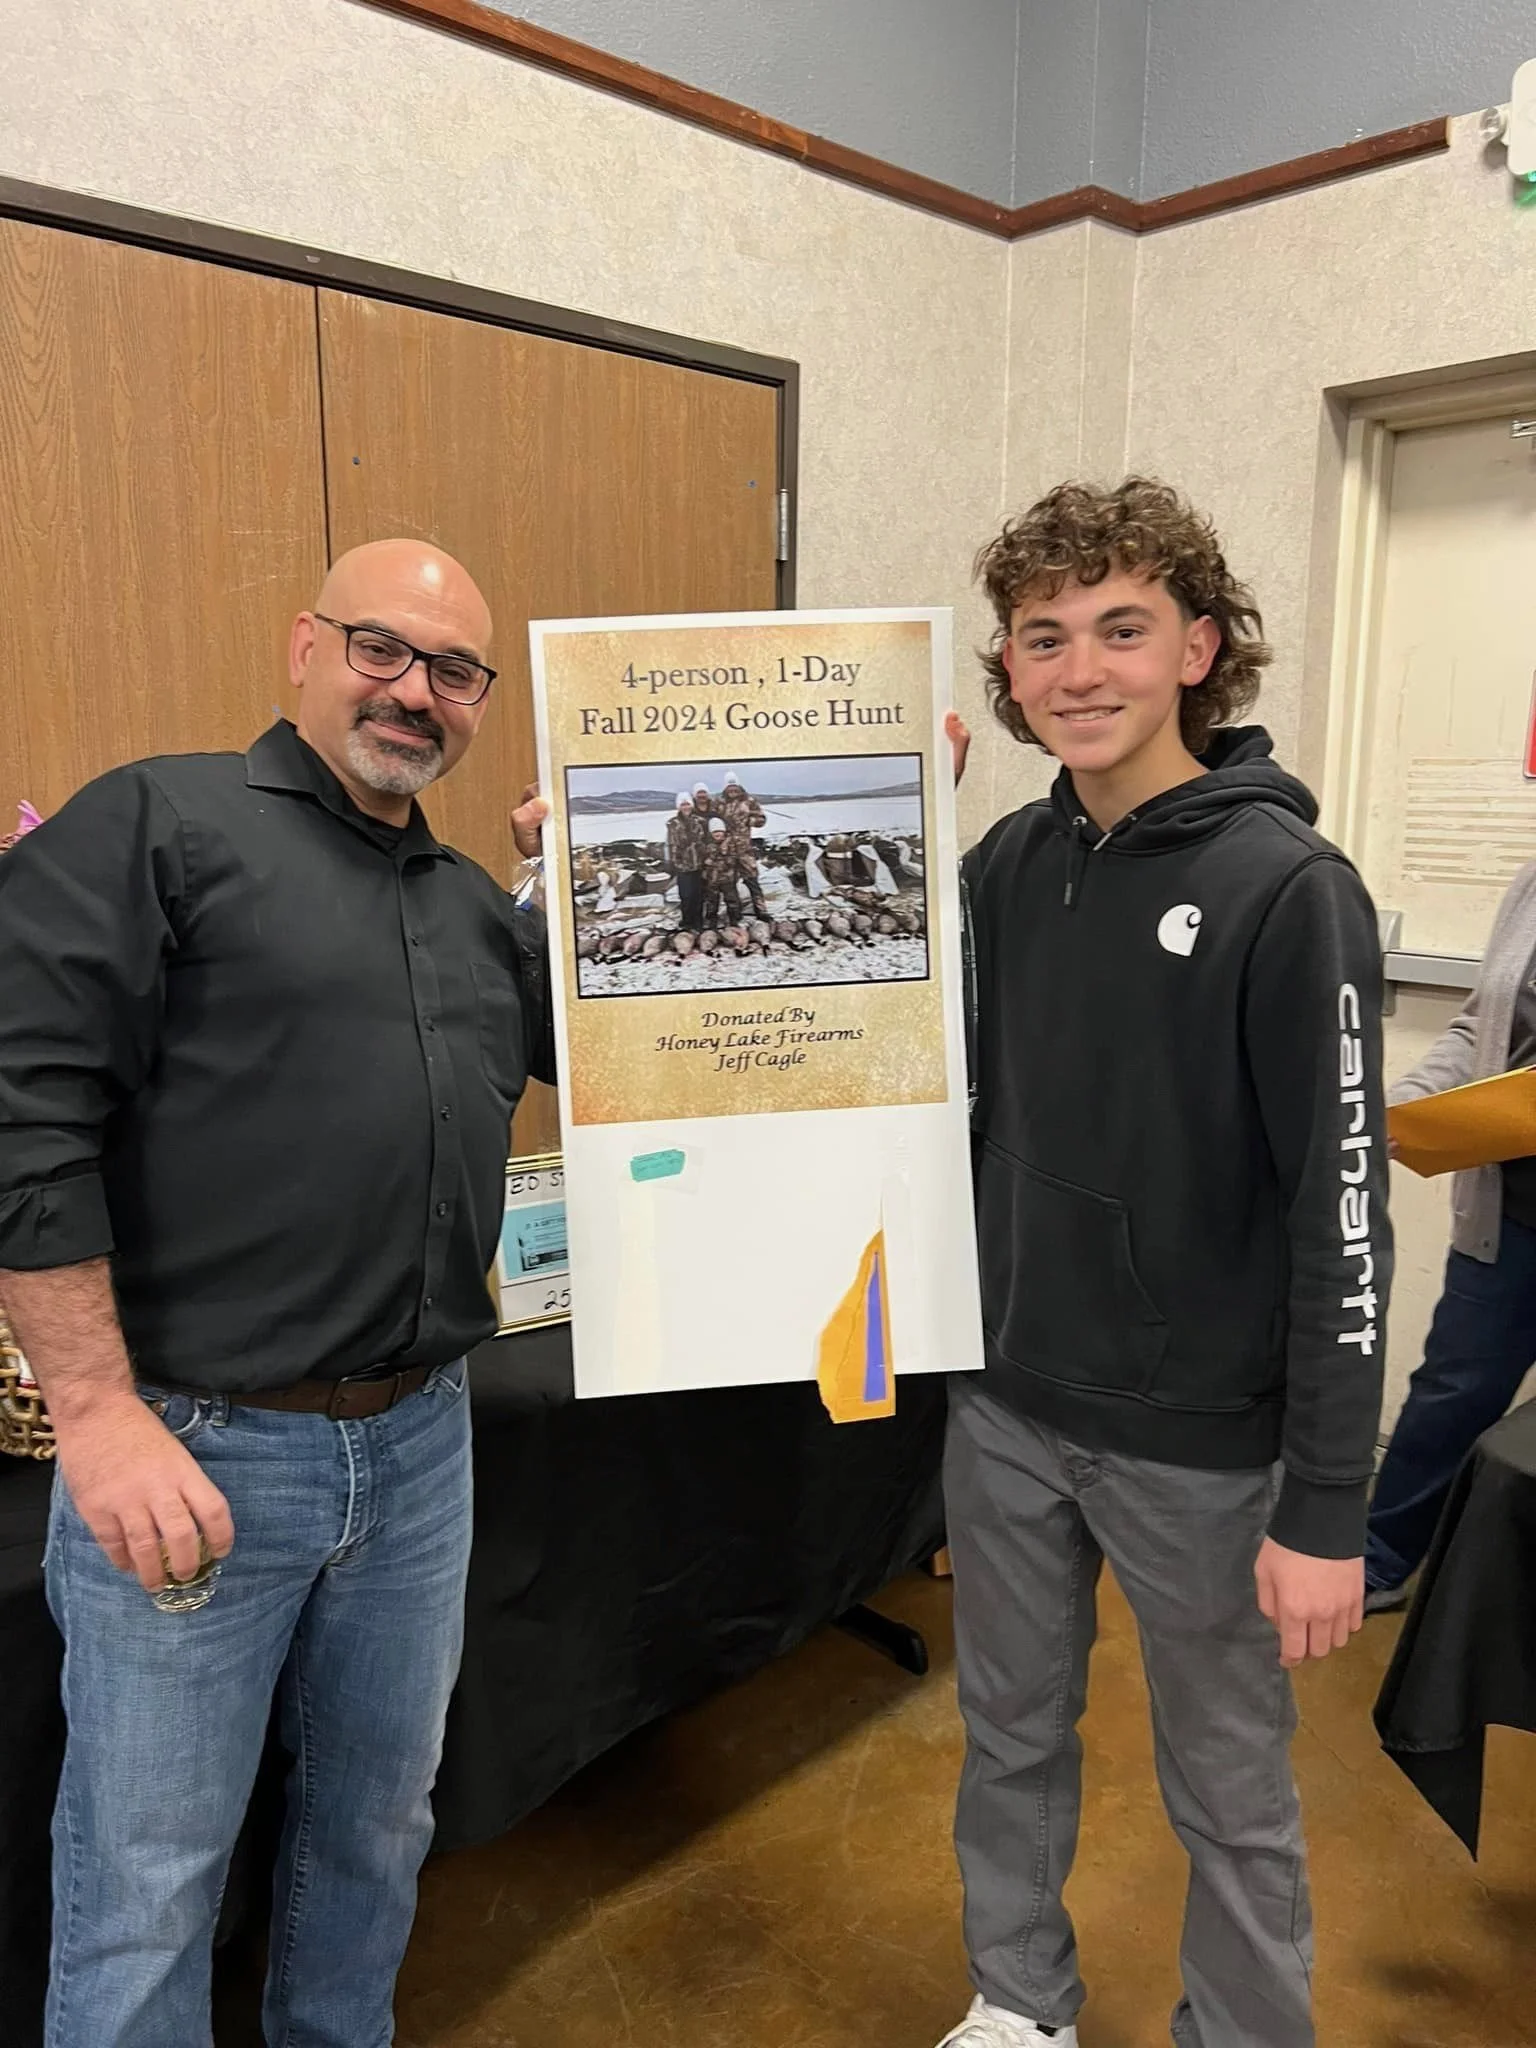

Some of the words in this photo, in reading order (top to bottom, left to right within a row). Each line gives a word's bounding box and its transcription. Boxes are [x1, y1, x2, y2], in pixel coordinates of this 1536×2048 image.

[621, 662, 748, 694] 4-person
[777, 656, 861, 685] 1-Day
[579, 706, 637, 735] Fall
[643, 703, 716, 733] 2024
[726, 702, 820, 730] Goose
[827, 698, 905, 727] Hunt
[702, 1006, 788, 1028] Donated
[789, 1007, 816, 1026] By
[656, 1033, 719, 1054] Honey
[725, 1029, 771, 1048] Lake
[773, 1027, 865, 1048] Firearms
[714, 1049, 754, 1074] Jeff
[755, 1048, 807, 1072] Cagle
[1337, 983, 1379, 1356] carhartt
